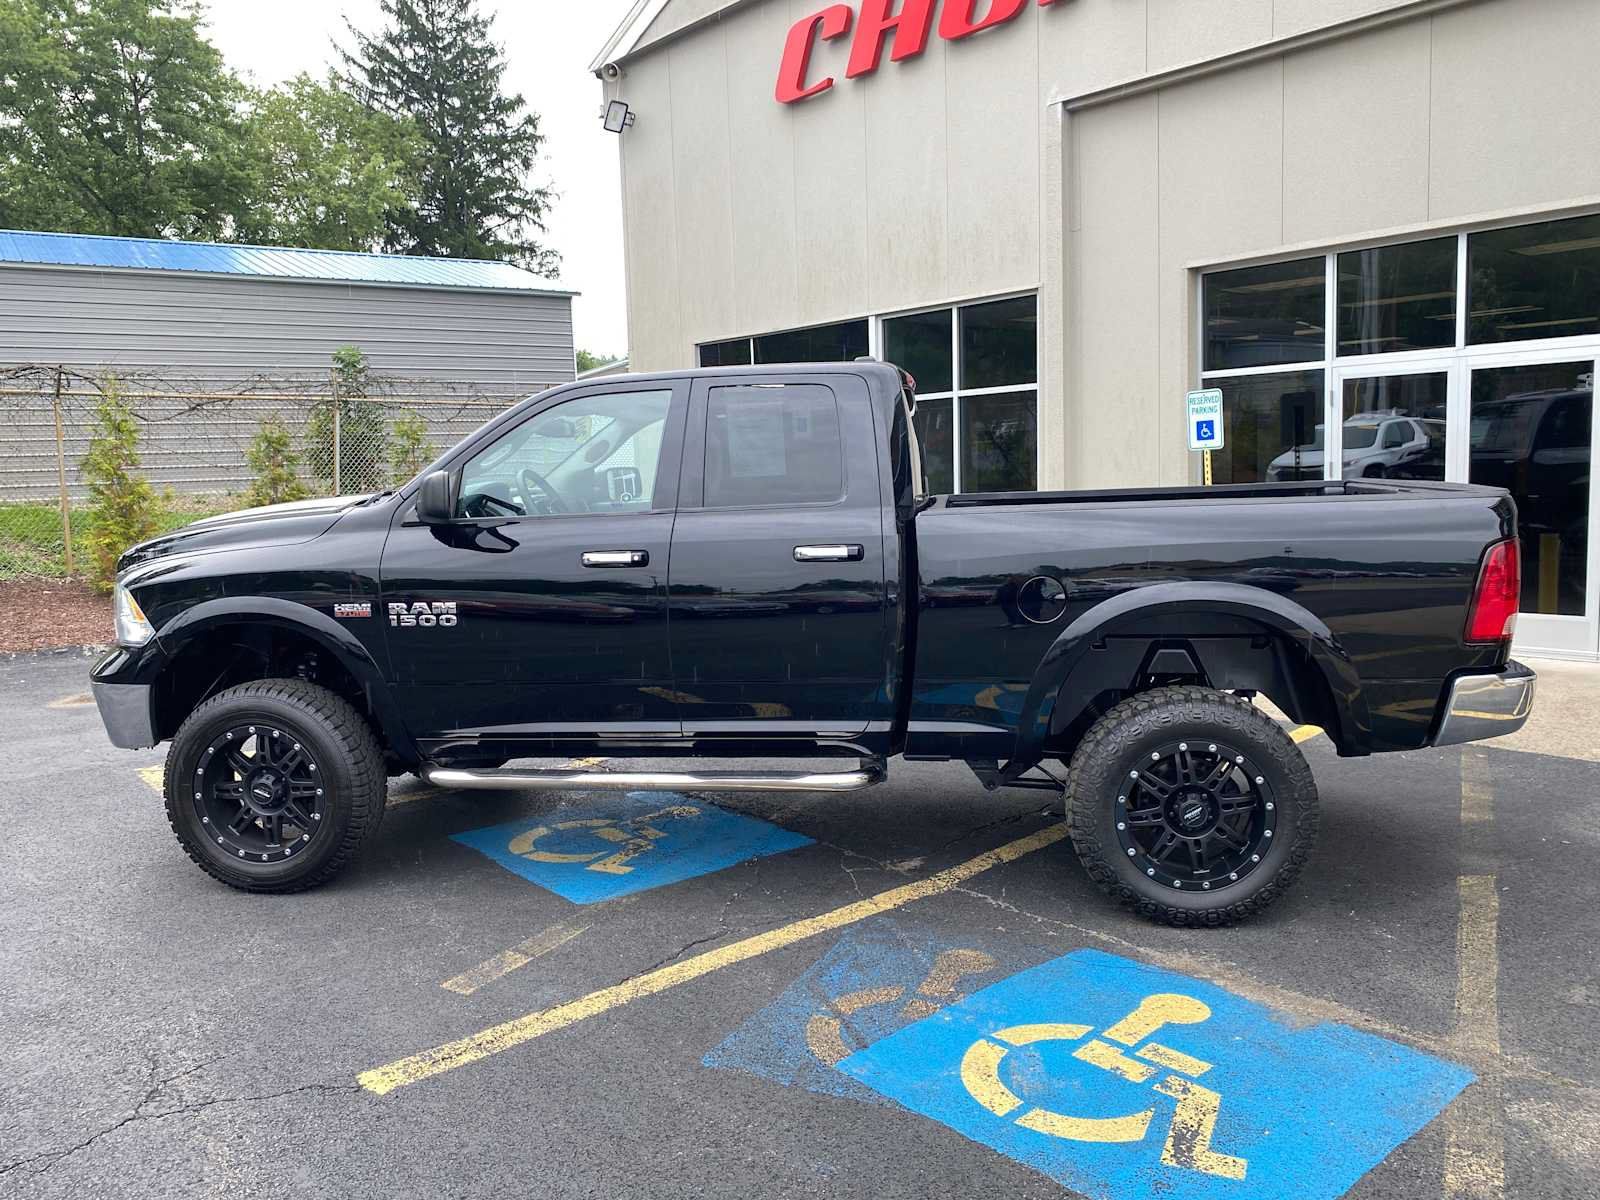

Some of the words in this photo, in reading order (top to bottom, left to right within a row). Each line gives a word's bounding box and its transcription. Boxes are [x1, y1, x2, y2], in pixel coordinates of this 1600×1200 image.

[1189, 395, 1219, 405] RESERVED
[1191, 405, 1218, 416] PARKING
[388, 602, 457, 615] RAM
[389, 615, 457, 626] 1500
